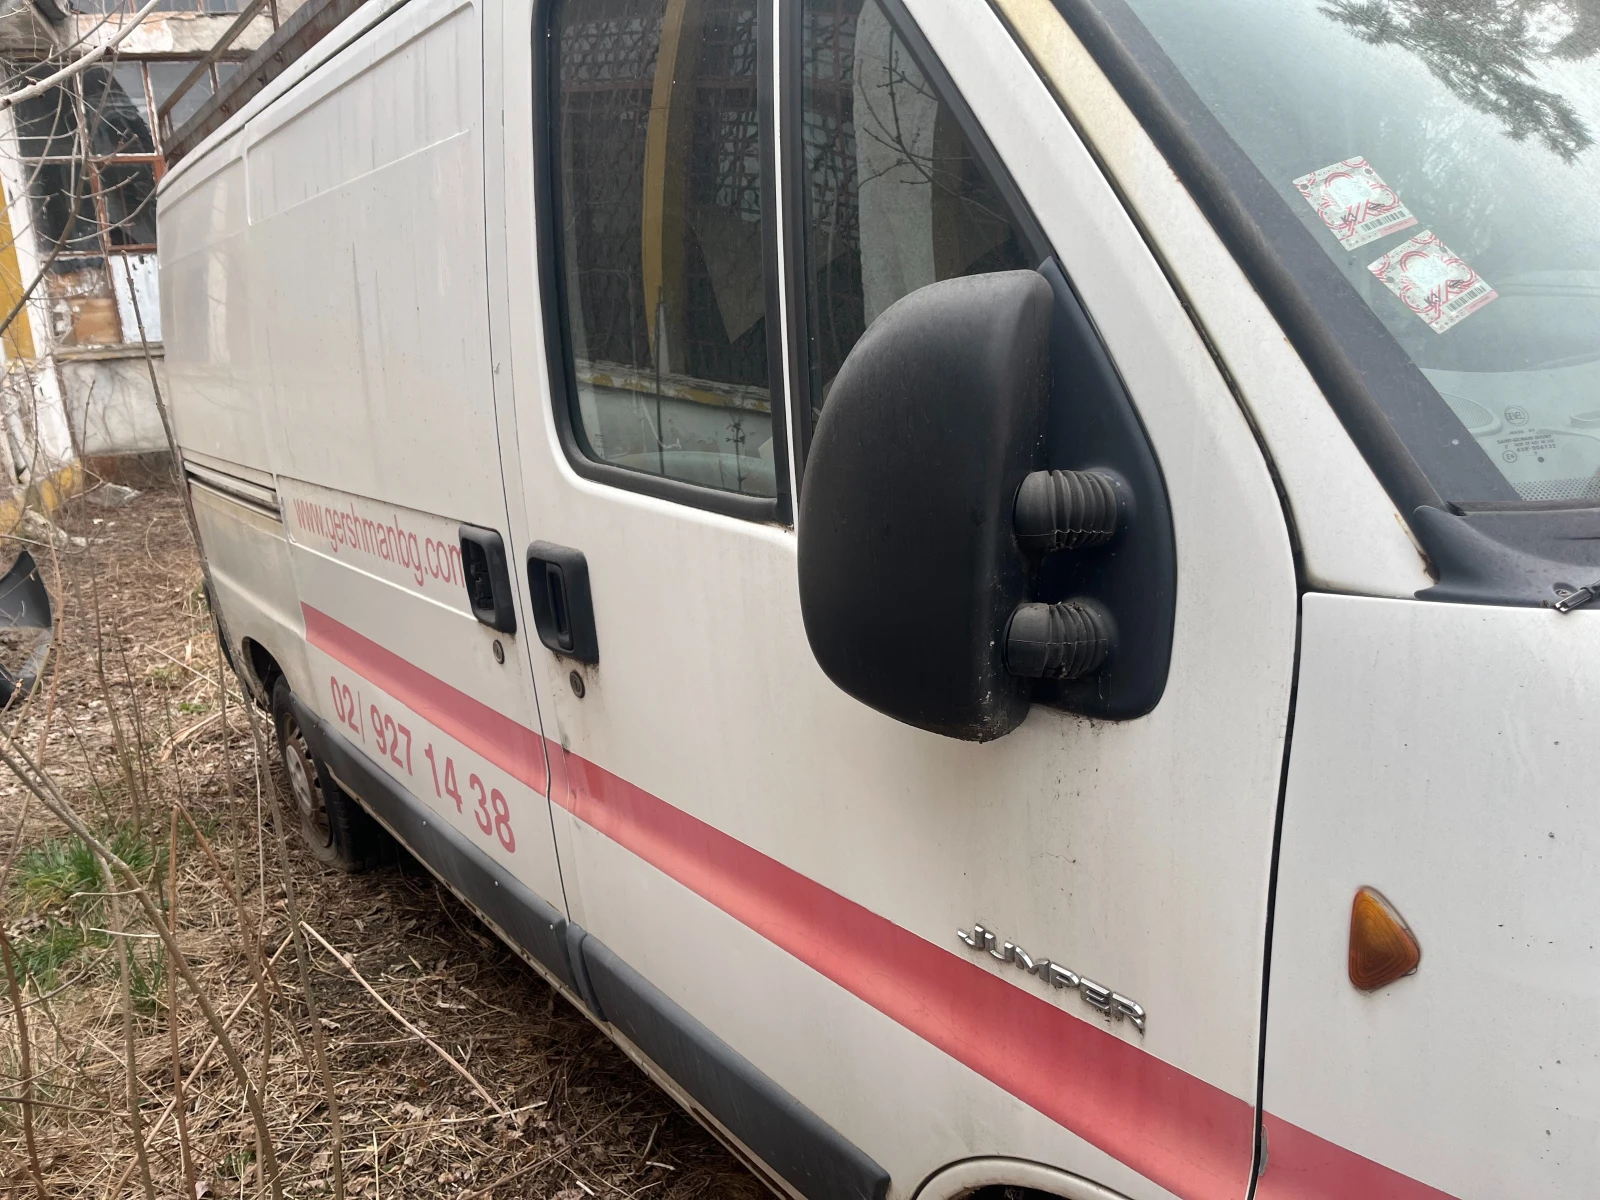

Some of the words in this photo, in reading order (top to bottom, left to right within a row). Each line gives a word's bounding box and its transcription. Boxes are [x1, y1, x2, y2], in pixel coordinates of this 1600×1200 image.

[1505, 411, 1524, 420] SEVEL
[370, 704, 413, 776] 927
[424, 743, 463, 814] 14
[470, 773, 516, 853] 38
[957, 923, 1146, 1029] JUMPER
